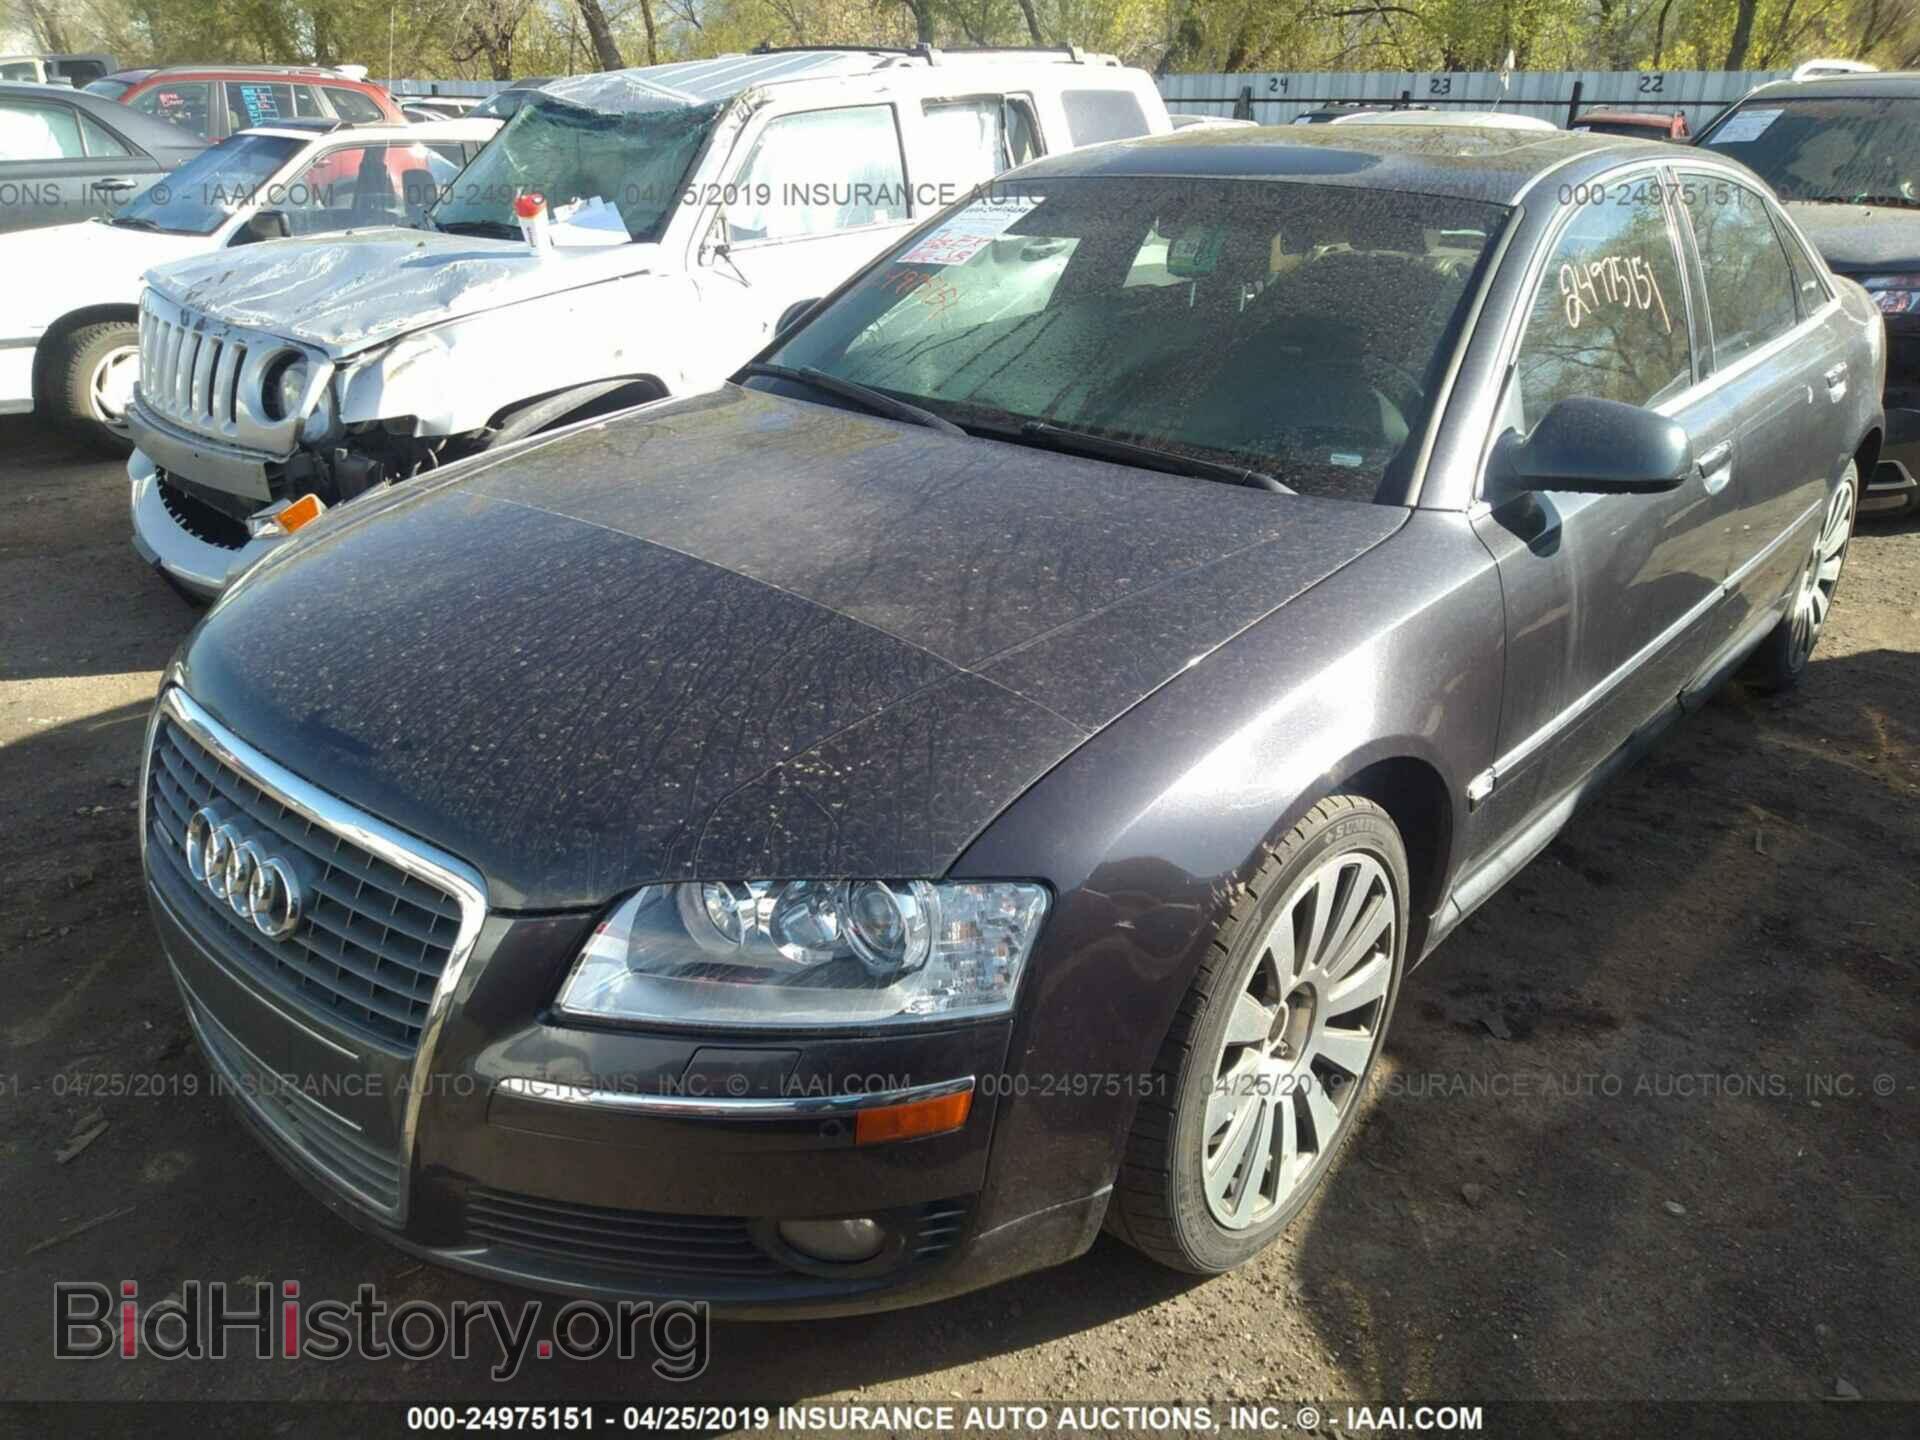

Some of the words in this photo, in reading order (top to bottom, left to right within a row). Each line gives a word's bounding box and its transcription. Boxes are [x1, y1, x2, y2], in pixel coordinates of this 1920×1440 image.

[1270, 77, 1288, 94] 24
[1430, 77, 1451, 95] 23
[1639, 75, 1663, 93] 22
[1560, 255, 1672, 335] 24975151
